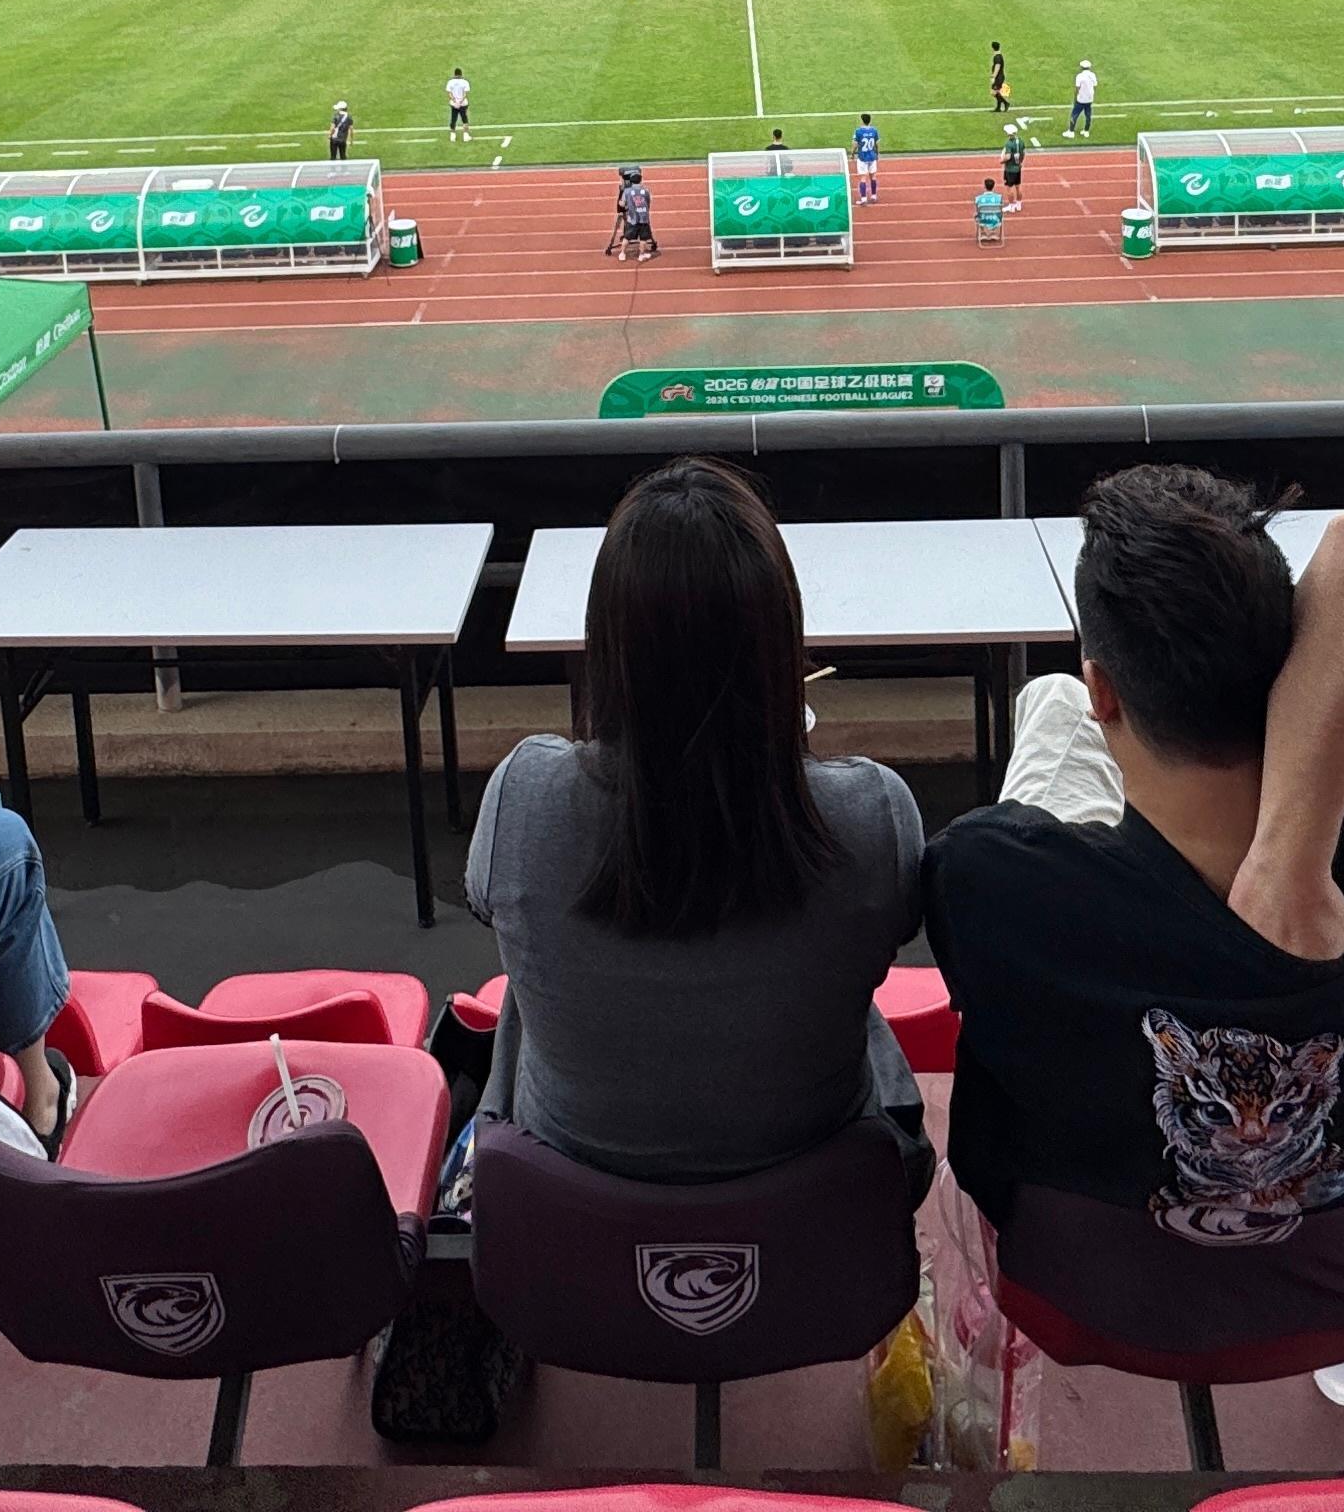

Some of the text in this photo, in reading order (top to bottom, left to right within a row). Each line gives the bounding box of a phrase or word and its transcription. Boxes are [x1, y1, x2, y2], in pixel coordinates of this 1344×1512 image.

[861, 137, 875, 152] 20
[704, 377, 748, 392] 2026
[778, 393, 817, 403] CHINESE
[819, 392, 868, 402] FOOTBALL
